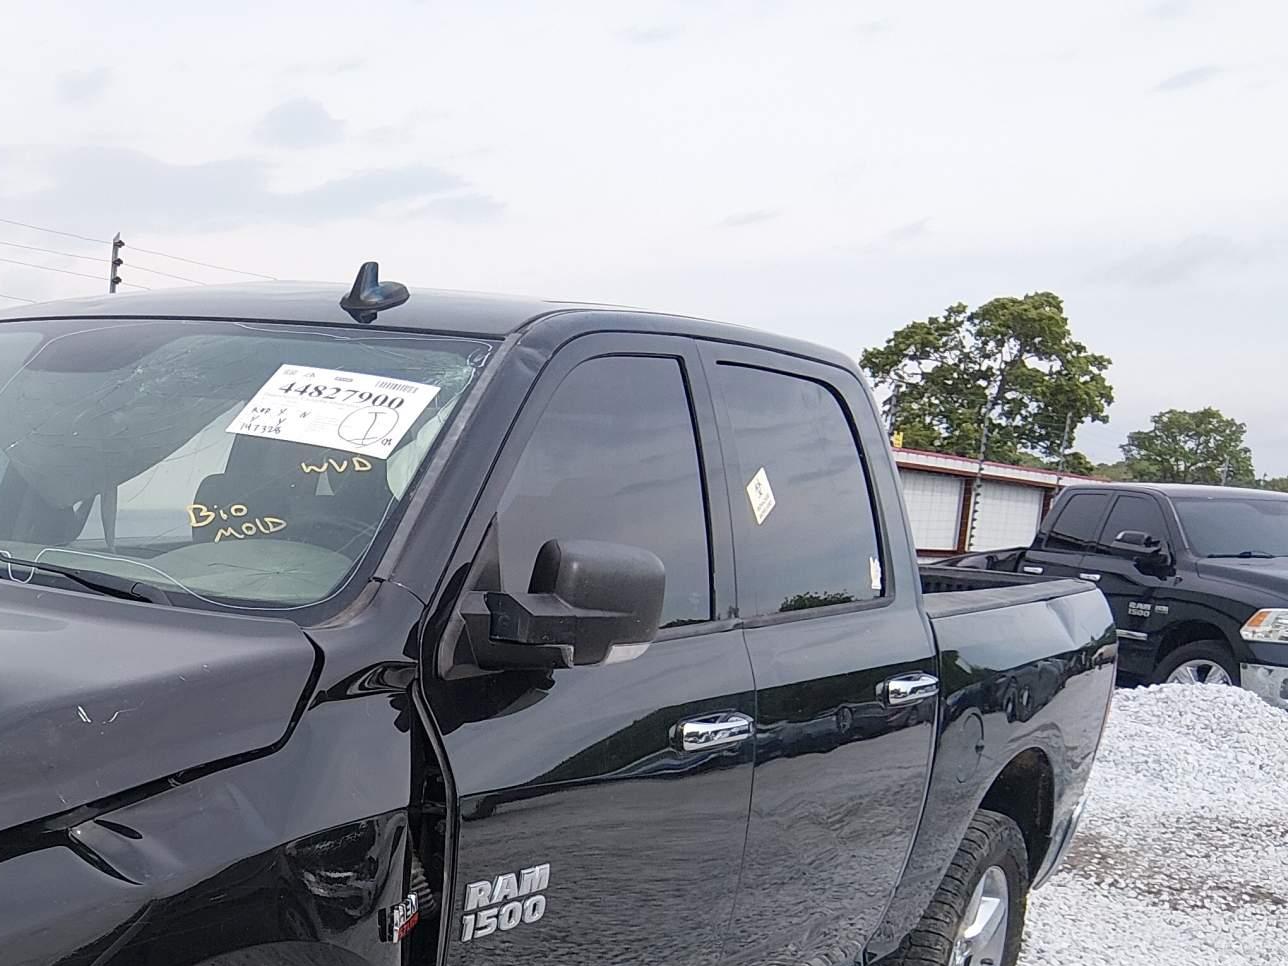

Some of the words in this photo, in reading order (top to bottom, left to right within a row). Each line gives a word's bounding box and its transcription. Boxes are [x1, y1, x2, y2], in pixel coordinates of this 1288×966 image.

[278, 381, 406, 410] 44827900
[300, 456, 372, 473] WVD
[464, 863, 550, 912] RAM
[461, 894, 547, 943] 1500
